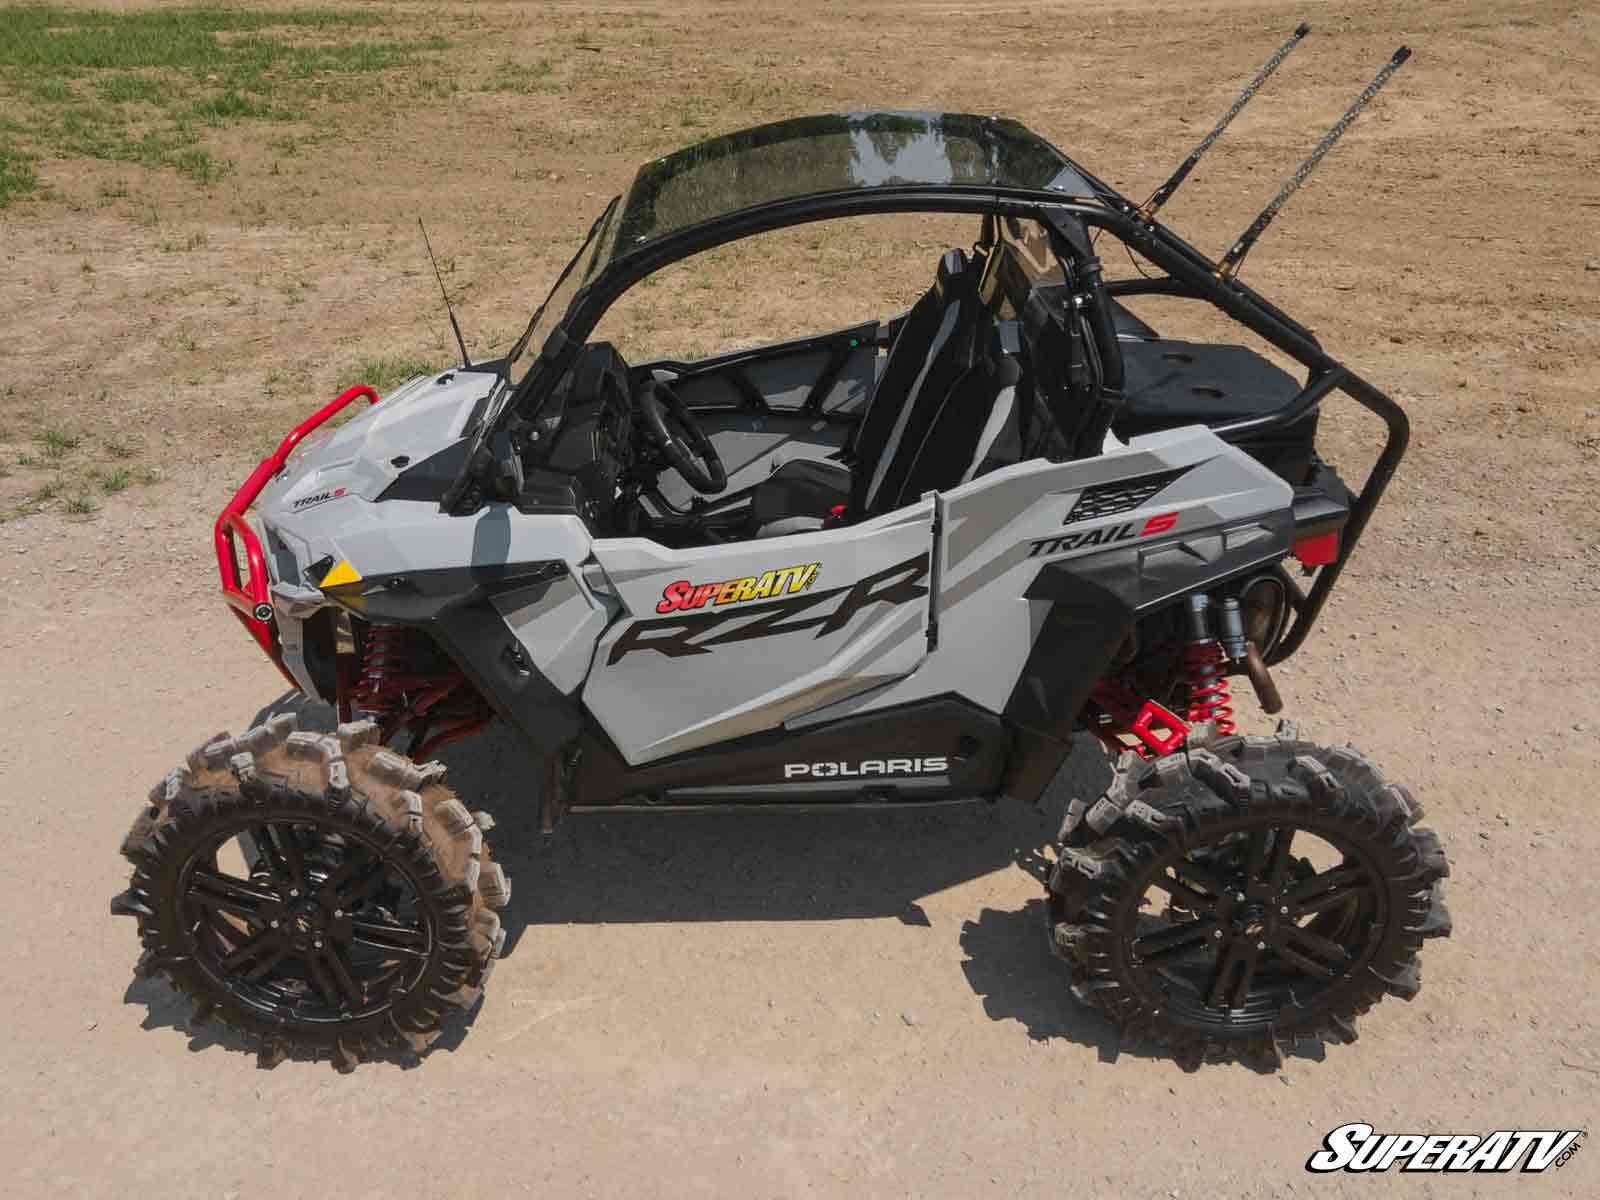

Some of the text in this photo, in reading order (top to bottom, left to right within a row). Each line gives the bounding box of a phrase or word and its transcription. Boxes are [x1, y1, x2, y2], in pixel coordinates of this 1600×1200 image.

[1028, 522, 1135, 558] TRAIL
[607, 552, 929, 666] RZR
[656, 564, 818, 614] SUPERATV
[784, 756, 948, 778] POLARIS
